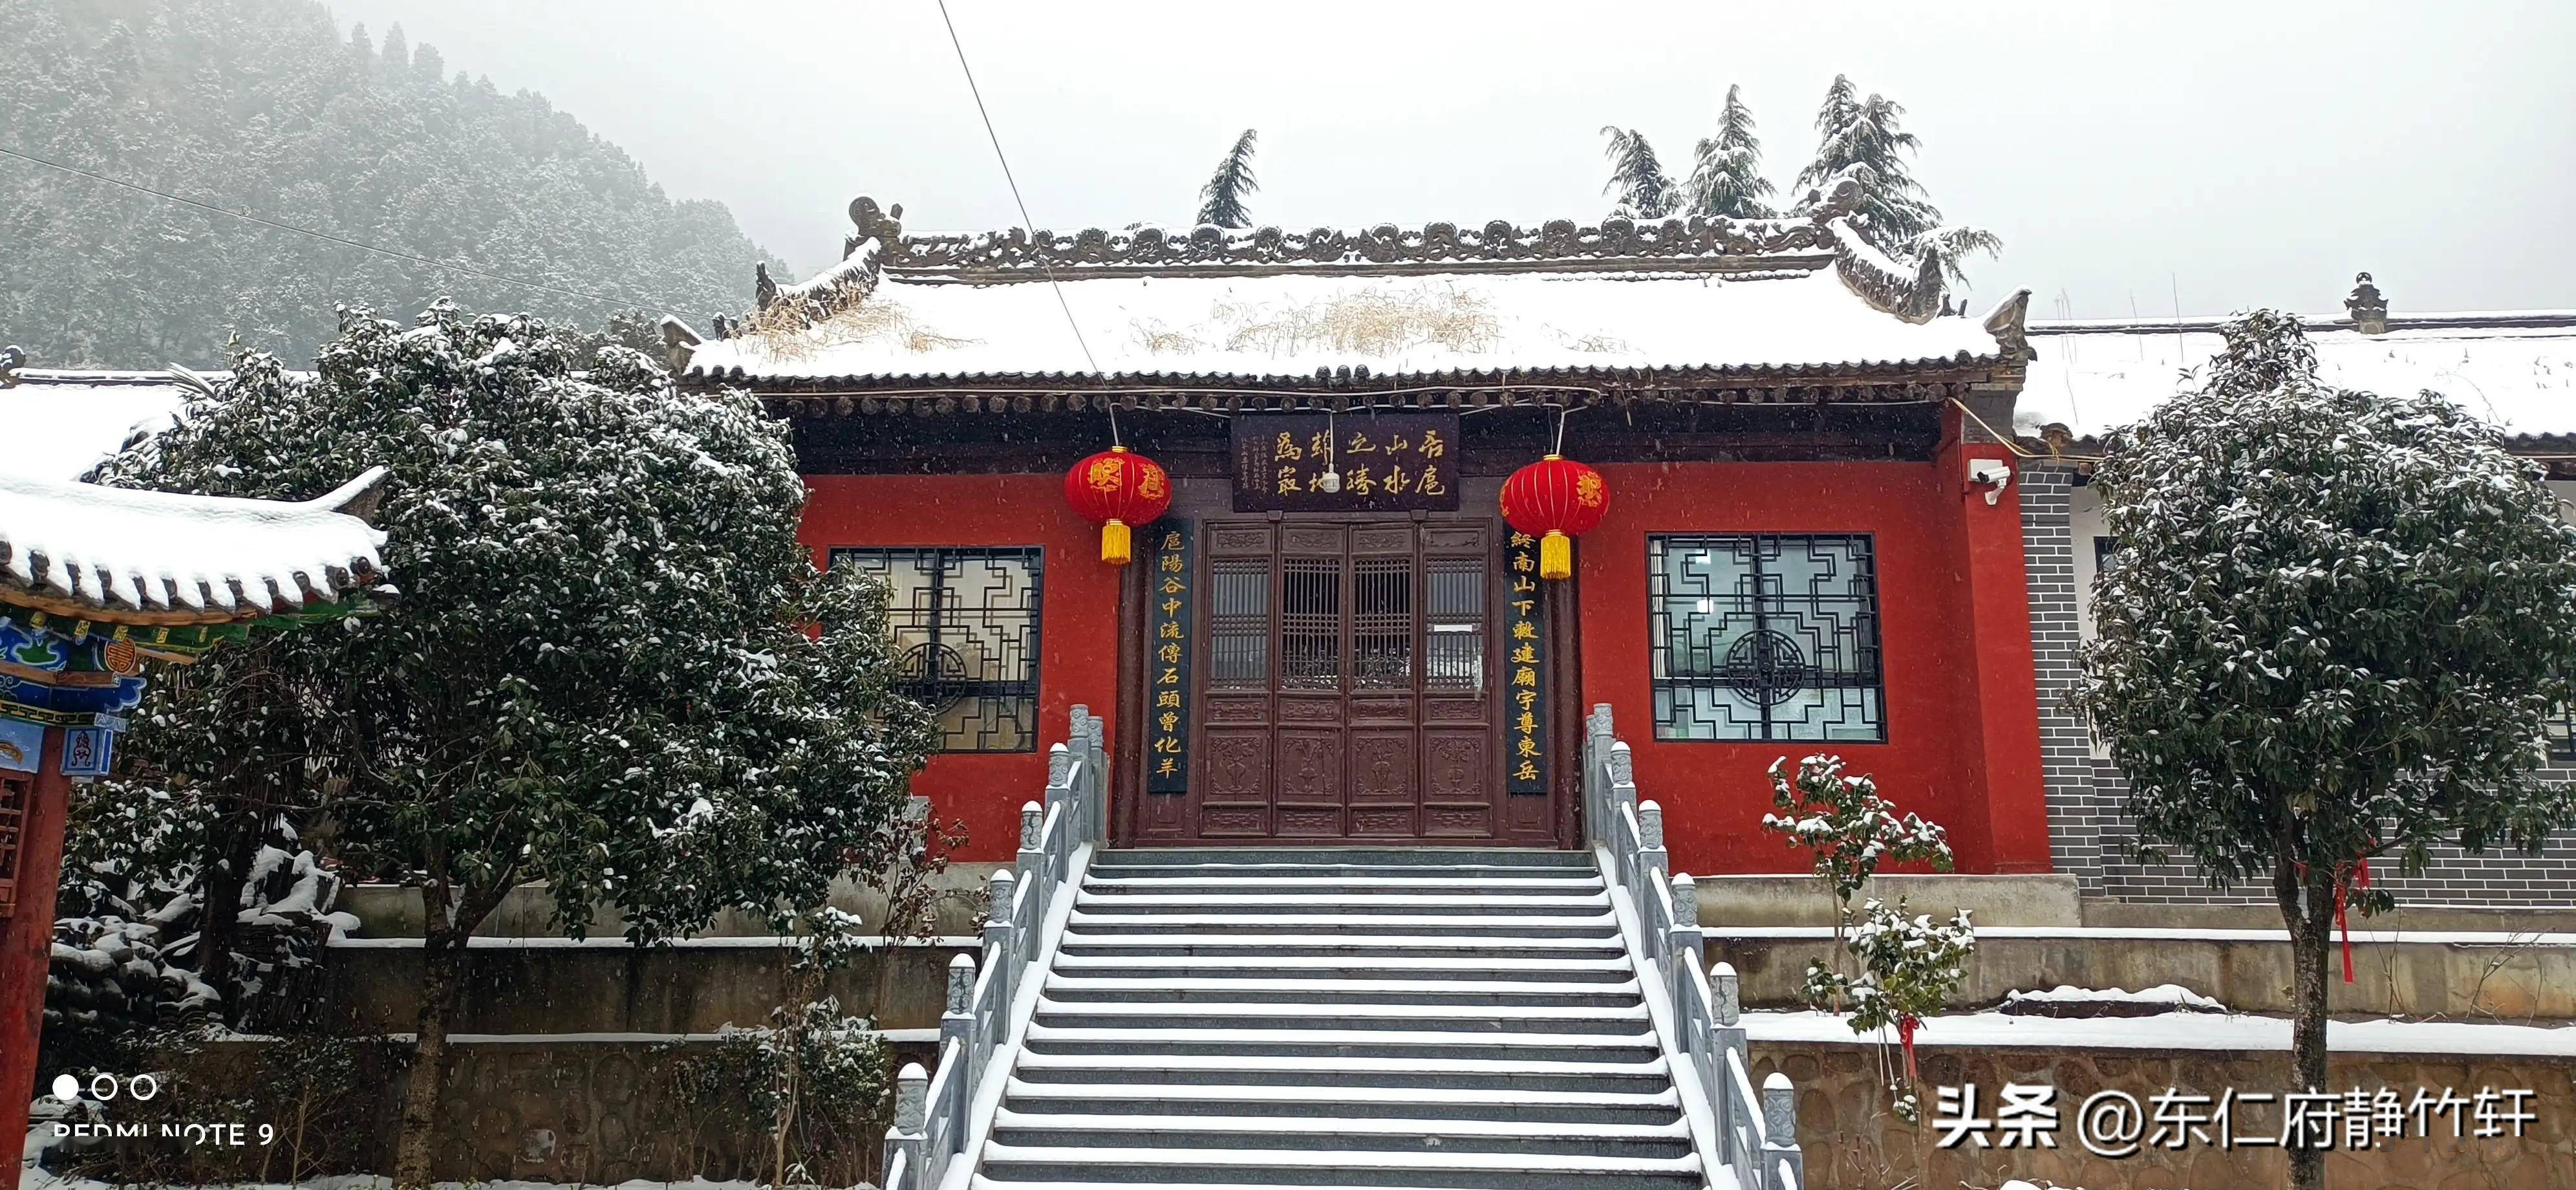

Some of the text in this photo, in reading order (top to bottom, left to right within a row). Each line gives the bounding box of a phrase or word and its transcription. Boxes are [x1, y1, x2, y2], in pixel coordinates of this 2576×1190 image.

[1154, 531, 1186, 779] 扈陽谷中流傳石頭曾化羊
